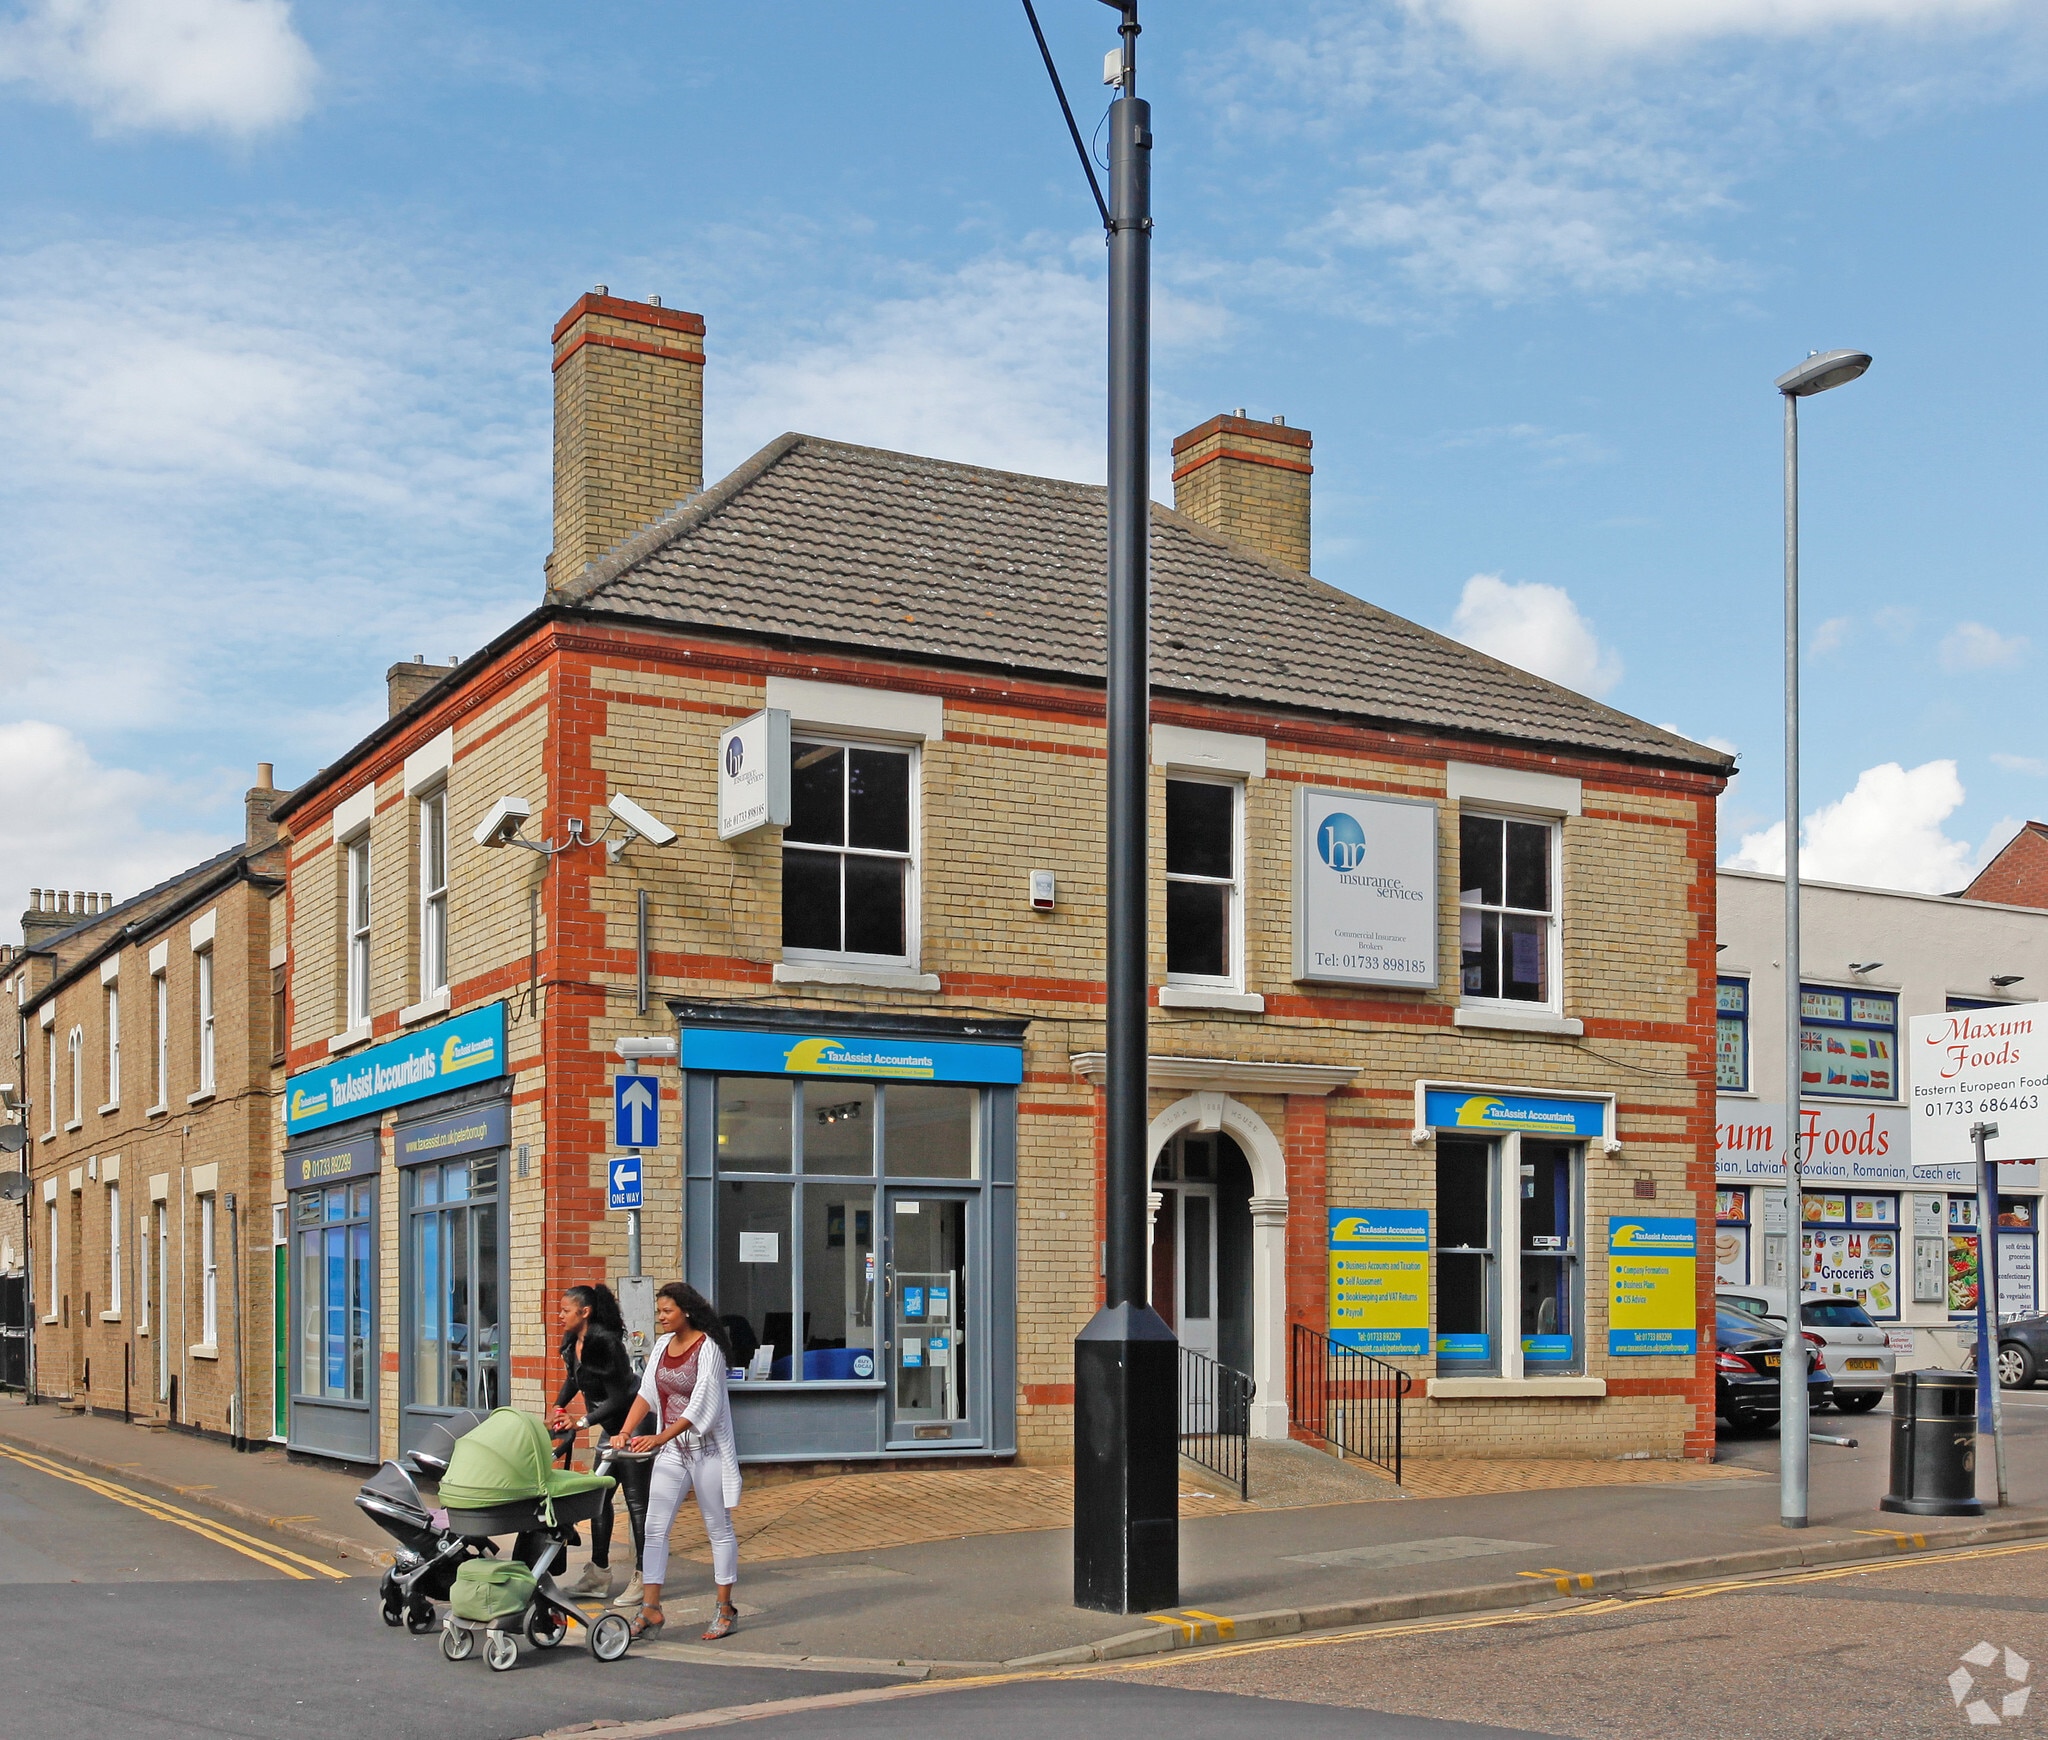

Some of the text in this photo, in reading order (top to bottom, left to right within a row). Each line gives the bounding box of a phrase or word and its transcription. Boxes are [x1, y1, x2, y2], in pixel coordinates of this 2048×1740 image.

[1325, 826, 1366, 869] hr
[1340, 873, 1401, 889] insurance
[1376, 885, 1424, 901] services
[1334, 928, 1407, 942] Commercial Insurance
[1358, 941, 1384, 951] Brokers
[1315, 952, 1426, 973] Tel: 01733 898185
[1926, 1016, 2033, 1045] Maxum
[826, 1050, 933, 1066] TaxAssist Accountants
[1940, 1041, 2020, 1078] Foods
[330, 1047, 436, 1107] TaxAssist Accountants
[1914, 1085, 1956, 1097] Eastern
[1960, 1080, 2016, 1093] European
[1925, 1095, 2038, 1117] 01733 686463
[1490, 1107, 1575, 1122] TaxAssist Accountants
[312, 1157, 330, 1178] 01733
[1800, 1160, 1849, 1178] lovakian,
[1853, 1163, 1909, 1180] Romanian,
[1912, 1164, 1943, 1180] Czech
[1947, 1168, 1961, 1181] etc
[611, 1191, 640, 1205] ONE WAY
[1358, 1225, 1425, 1235] TaxAssist Accountants
[1634, 1232, 1693, 1241] TaxAssist Accountants
[1345, 1261, 1421, 1270] Business Accounts and Taxation
[1623, 1266, 1670, 1276] Company Formations
[1821, 1265, 1875, 1279] Groceries
[1345, 1277, 1356, 1286] Self
[1623, 1280, 1643, 1289] Business
[1345, 1292, 1418, 1303] Bookkeeping and VAT Returns
[2006, 1292, 2031, 1301] vegetables
[1345, 1307, 1363, 1319] Payroll
[1358, 1332, 1366, 1342] Tel:
[1366, 1332, 1382, 1341] 01733
[1634, 1332, 1642, 1341] Tel:
